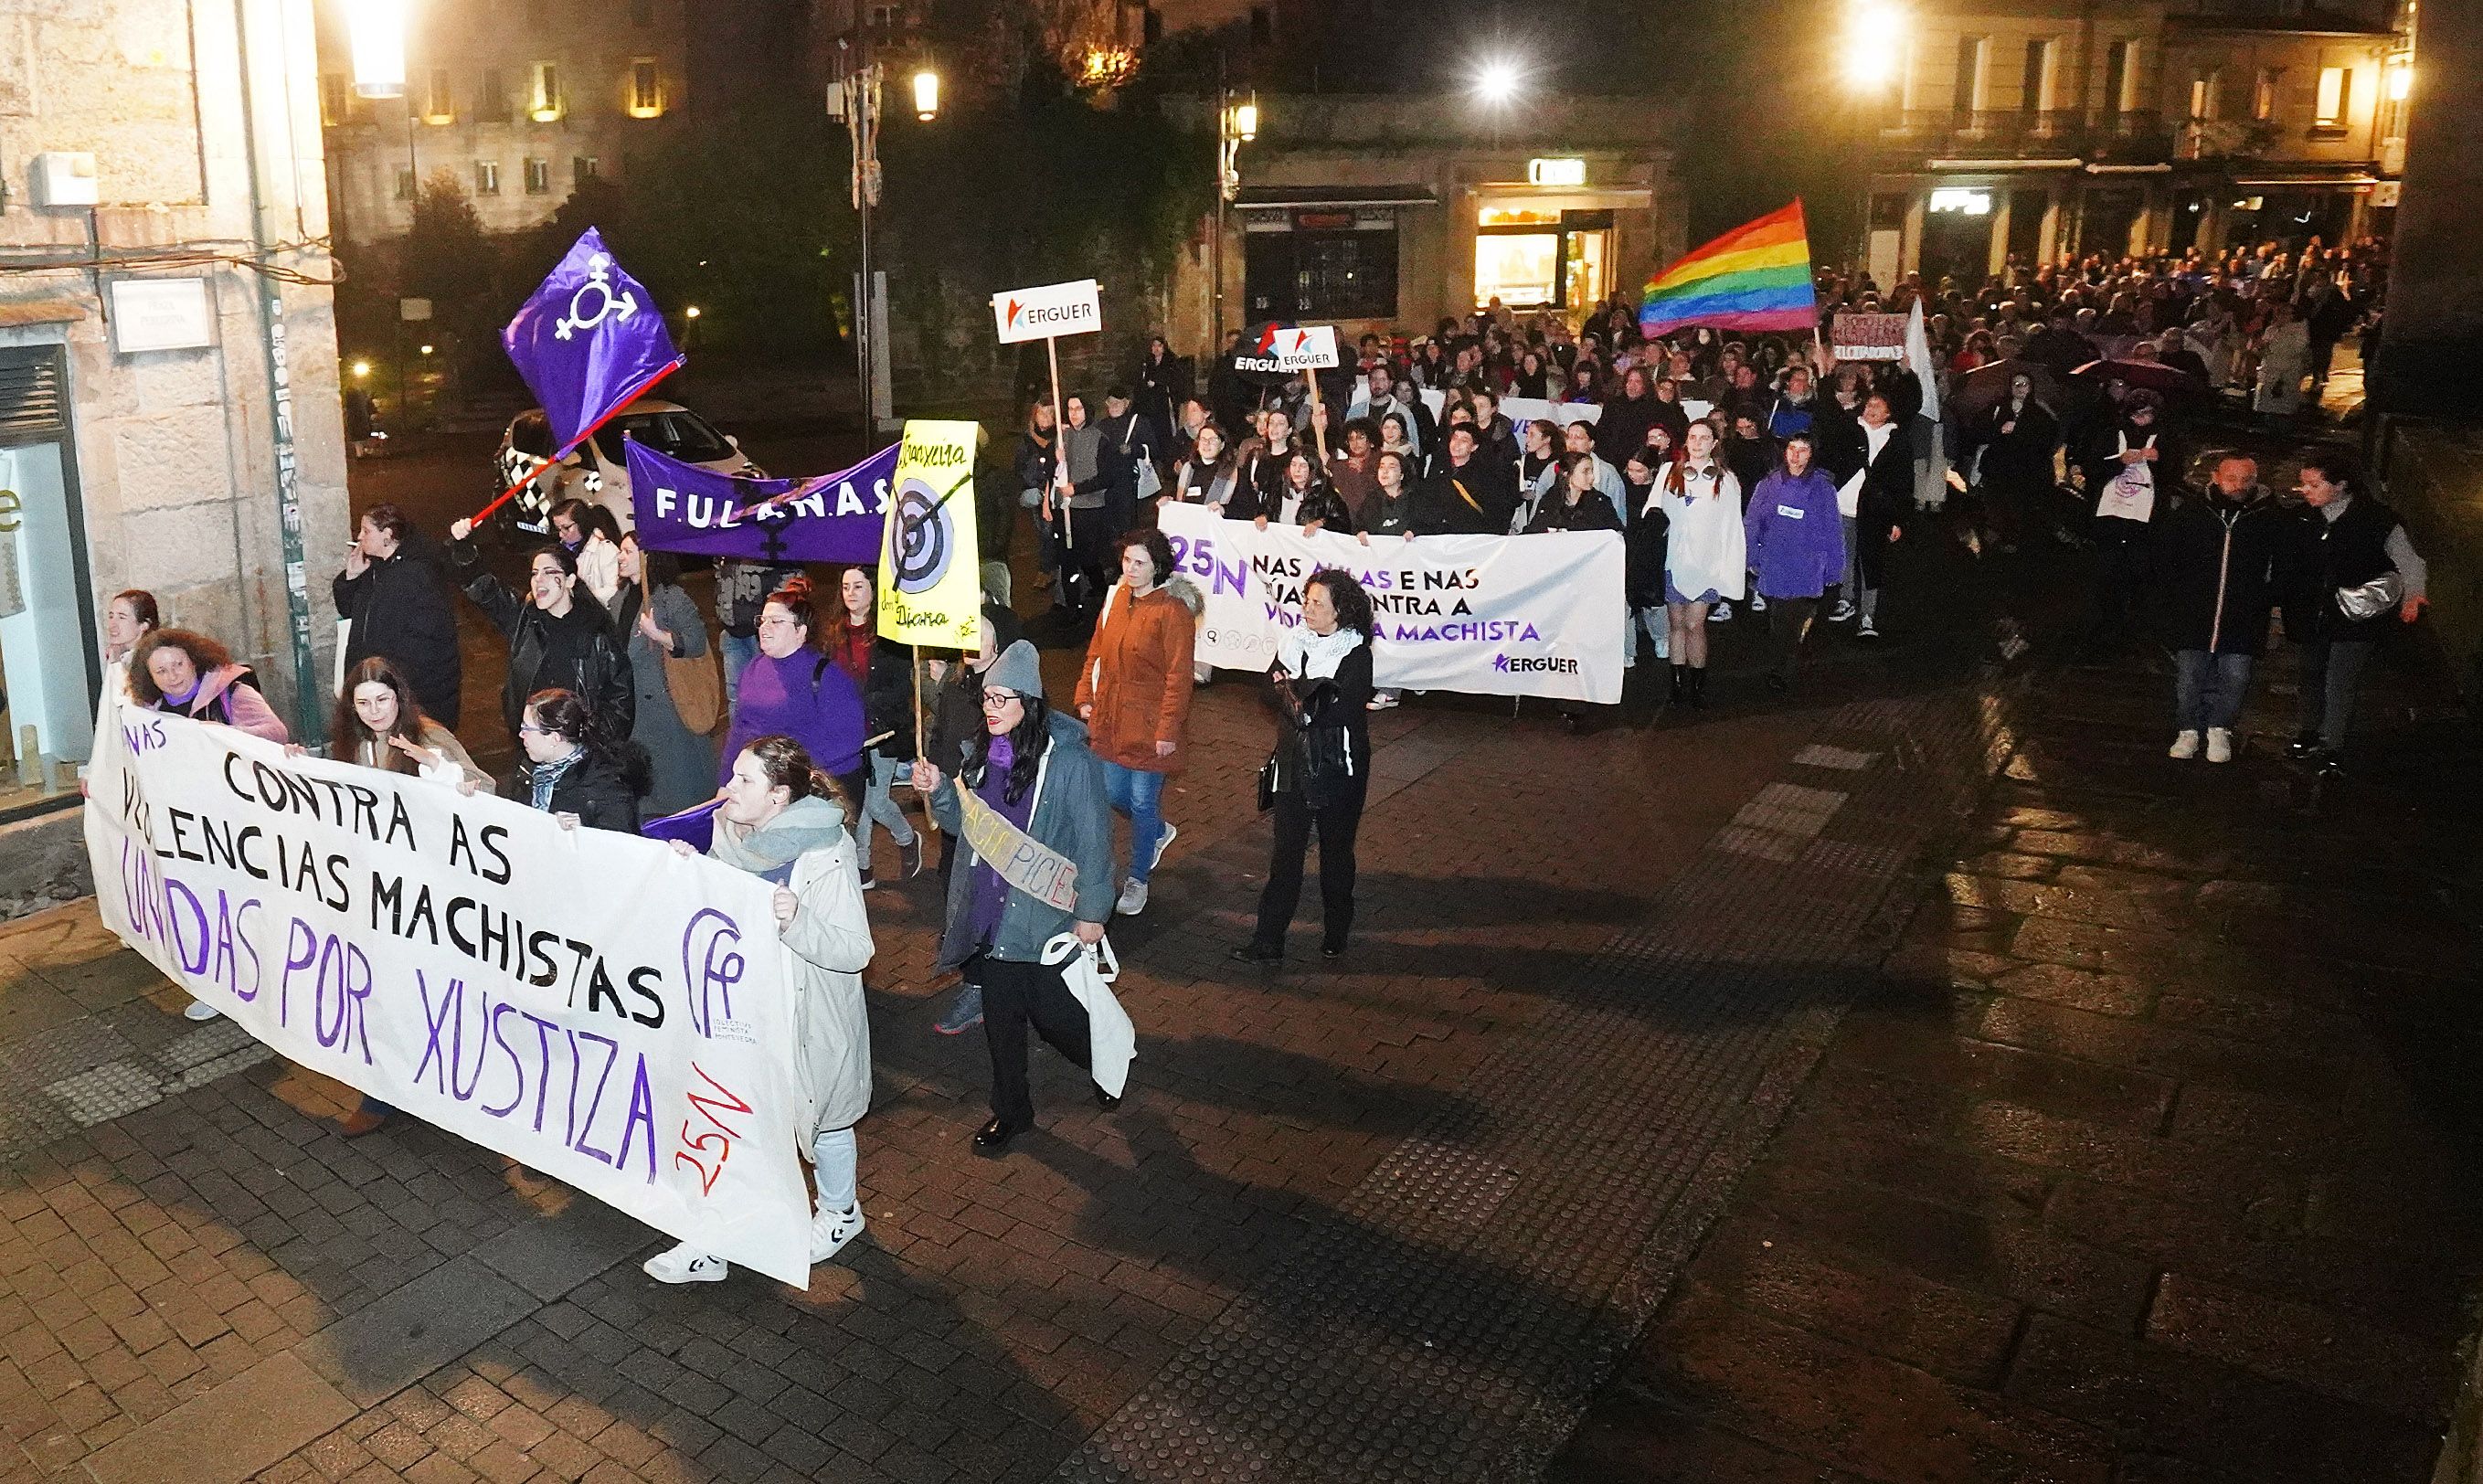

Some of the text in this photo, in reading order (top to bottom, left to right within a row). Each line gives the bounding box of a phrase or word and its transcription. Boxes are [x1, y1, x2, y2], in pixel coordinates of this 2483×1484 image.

[1028, 303, 1091, 323] ERGUER
[1235, 356, 1300, 374] ERGU
[1284, 354, 1331, 366] ERGUER
[1170, 535, 1247, 599] 25N
[1253, 555, 1301, 578] NAS
[1400, 571, 1414, 590] E
[1424, 568, 1480, 590] NAS
[1373, 594, 1442, 616] NTRA
[1451, 597, 1473, 615] A
[1395, 620, 1541, 641] MACHISTA
[1511, 657, 1578, 674] ERGUER
[224, 751, 511, 885] CONTRA AS
[371, 871, 664, 1028] MACHISTAS
[281, 917, 372, 1065] POR
[413, 969, 656, 1185] XUSTIZA
[674, 1061, 754, 1198] 25N
